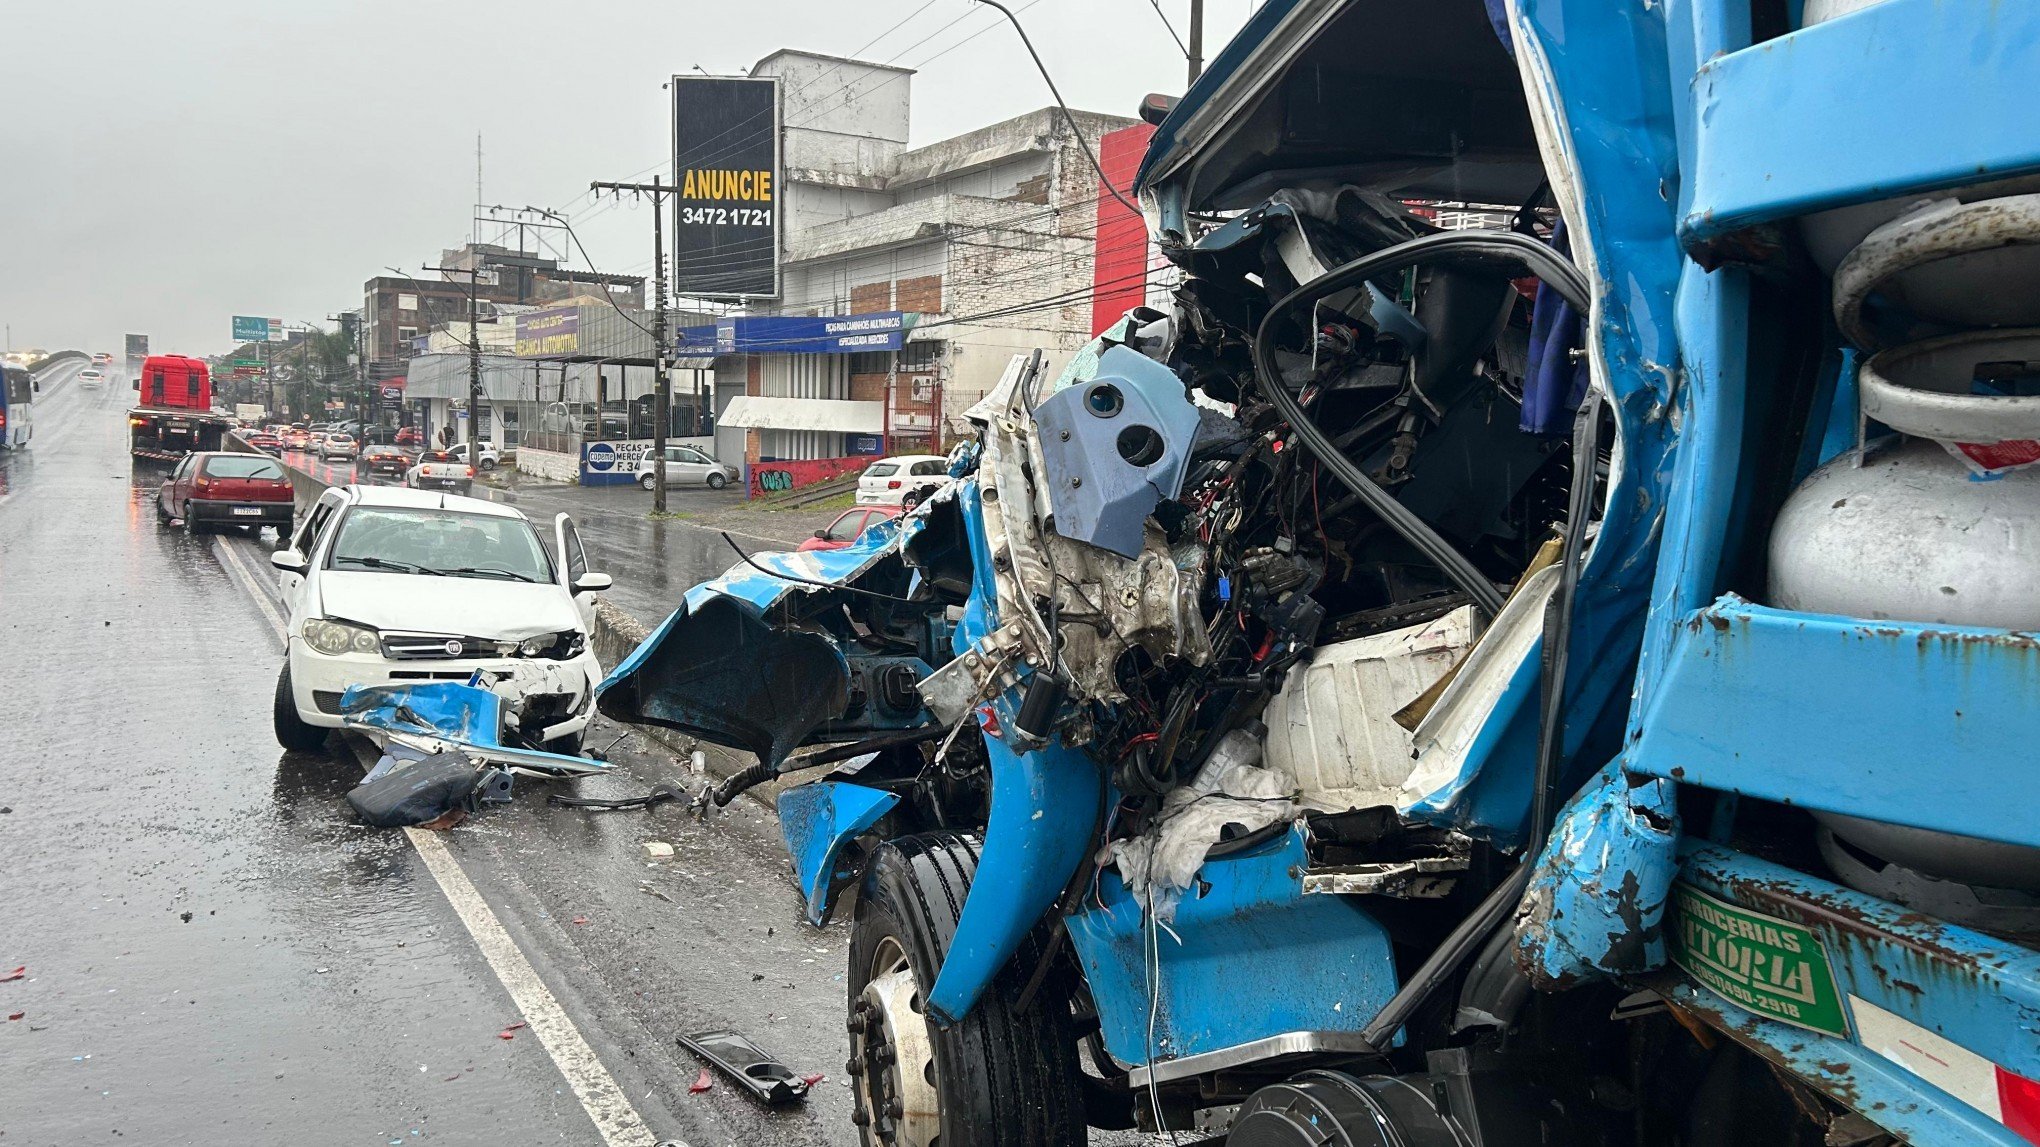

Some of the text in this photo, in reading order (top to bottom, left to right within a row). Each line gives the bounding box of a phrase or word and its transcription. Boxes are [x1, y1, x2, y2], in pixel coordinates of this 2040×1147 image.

[682, 169, 771, 201] ANUNCIE
[682, 207, 771, 226] 3472 1721
[837, 322, 846, 332] PARA
[846, 318, 870, 332] CAMINHÕES
[870, 317, 900, 330] MULTIMARCAS
[235, 328, 267, 336] Multistop
[542, 333, 578, 354] AUTOMOTIVA
[838, 334, 889, 346] ESPECIALIZADA MERCEDES
[589, 451, 615, 463] copeme
[616, 453, 640, 461] MERCE
[626, 462, 640, 472] 34
[1680, 893, 1801, 953] RROCERIAS
